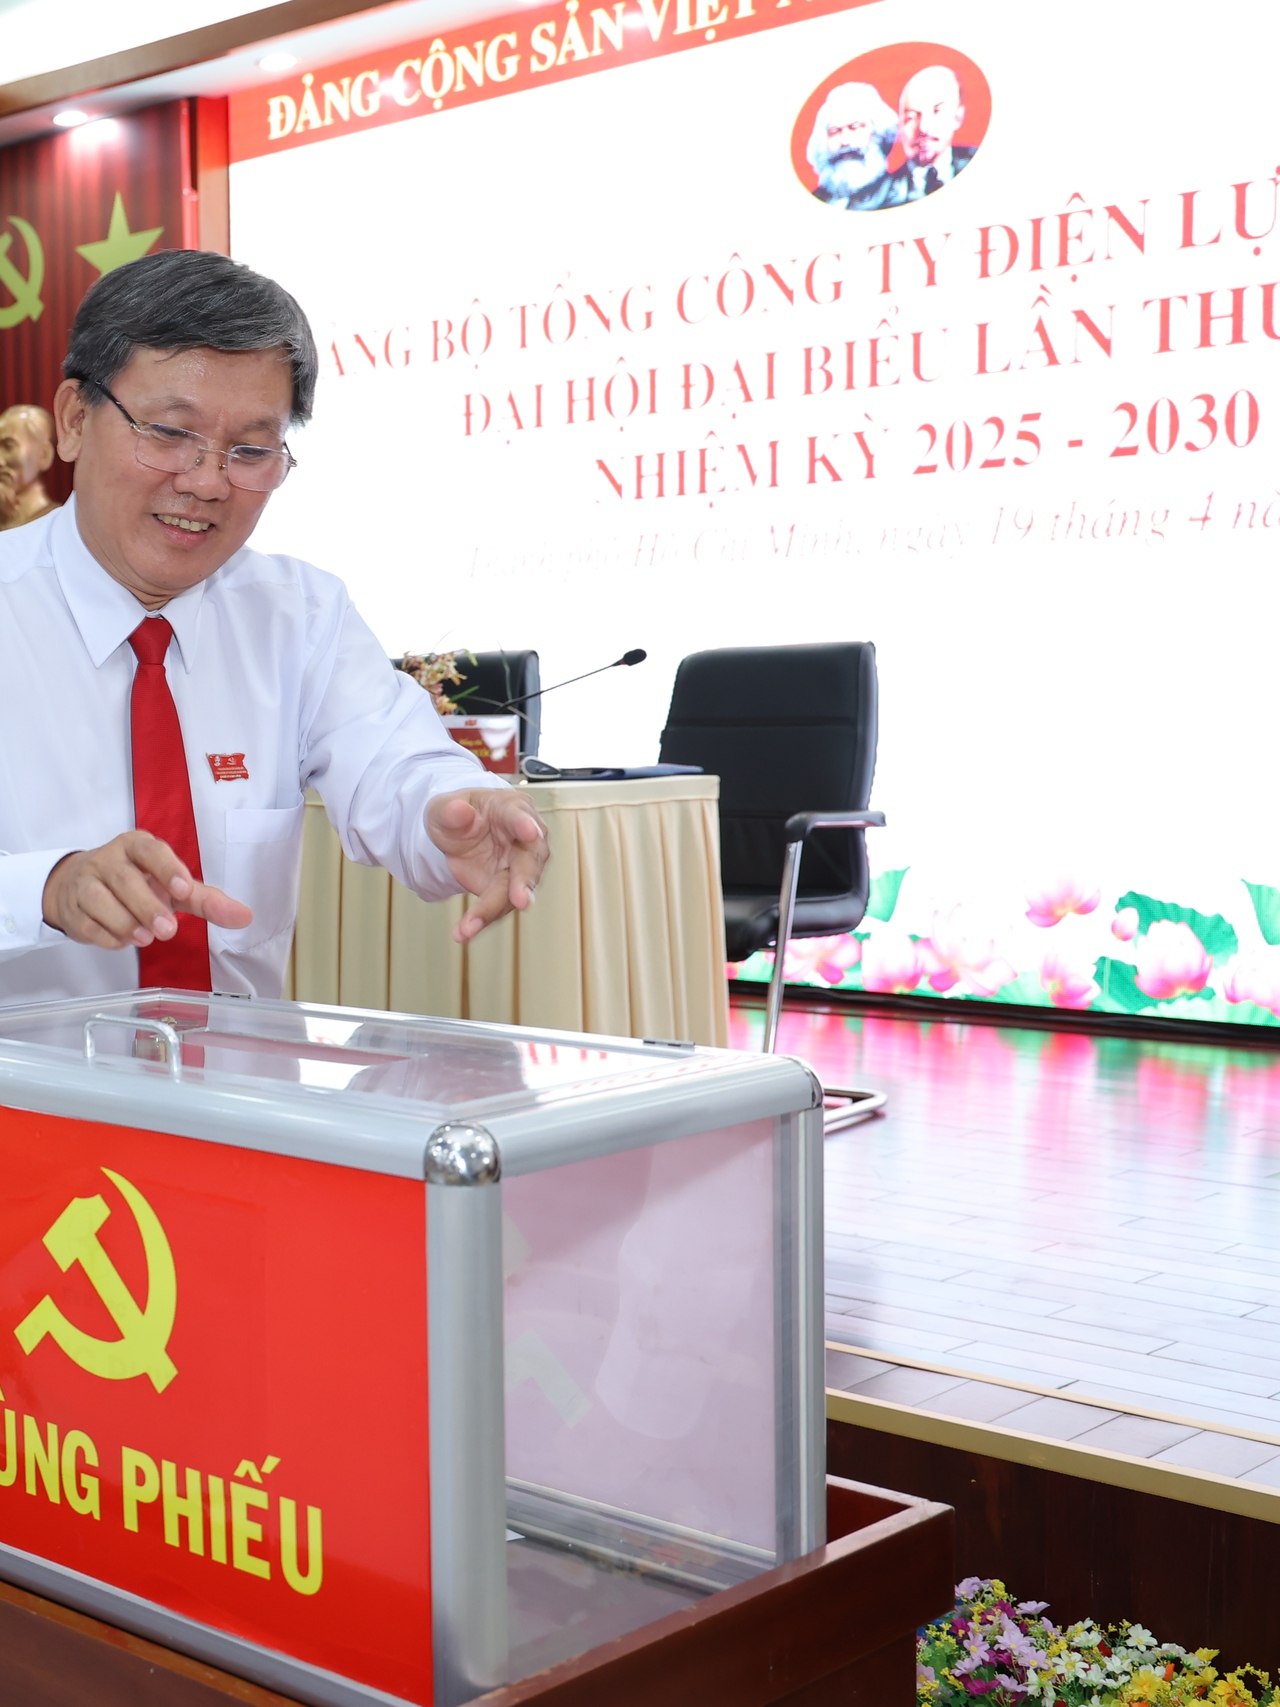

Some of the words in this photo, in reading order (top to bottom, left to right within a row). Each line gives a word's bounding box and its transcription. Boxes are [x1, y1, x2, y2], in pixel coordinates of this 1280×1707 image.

[267, 72, 381, 140] ĐẢNG
[391, 37, 521, 110] CỘNG
[530, 0, 623, 73] SẢN
[323, 322, 412, 377] ẢNG
[431, 297, 493, 370] BỘ
[508, 270, 654, 350] TỔNG
[676, 251, 844, 324] CÔNG
[867, 232, 953, 295] TY
[973, 191, 1151, 283] ĐIỆN
[462, 383, 544, 446] ĐẠI
[565, 355, 660, 433] HỘI
[678, 350, 779, 420] ĐẠI
[801, 304, 950, 397] BIỂU
[972, 283, 1117, 376] LẦN
[593, 428, 781, 510] NHIỆM
[806, 411, 890, 486] KỲ
[911, 411, 1042, 475] 2025
[1067, 438, 1084, 449] -
[1108, 387, 1260, 459] 2030
[991, 506, 1034, 545] 19
[1050, 498, 1170, 548] tháng
[1188, 490, 1215, 531] 4
[121, 1445, 324, 1596] PHIẾU
